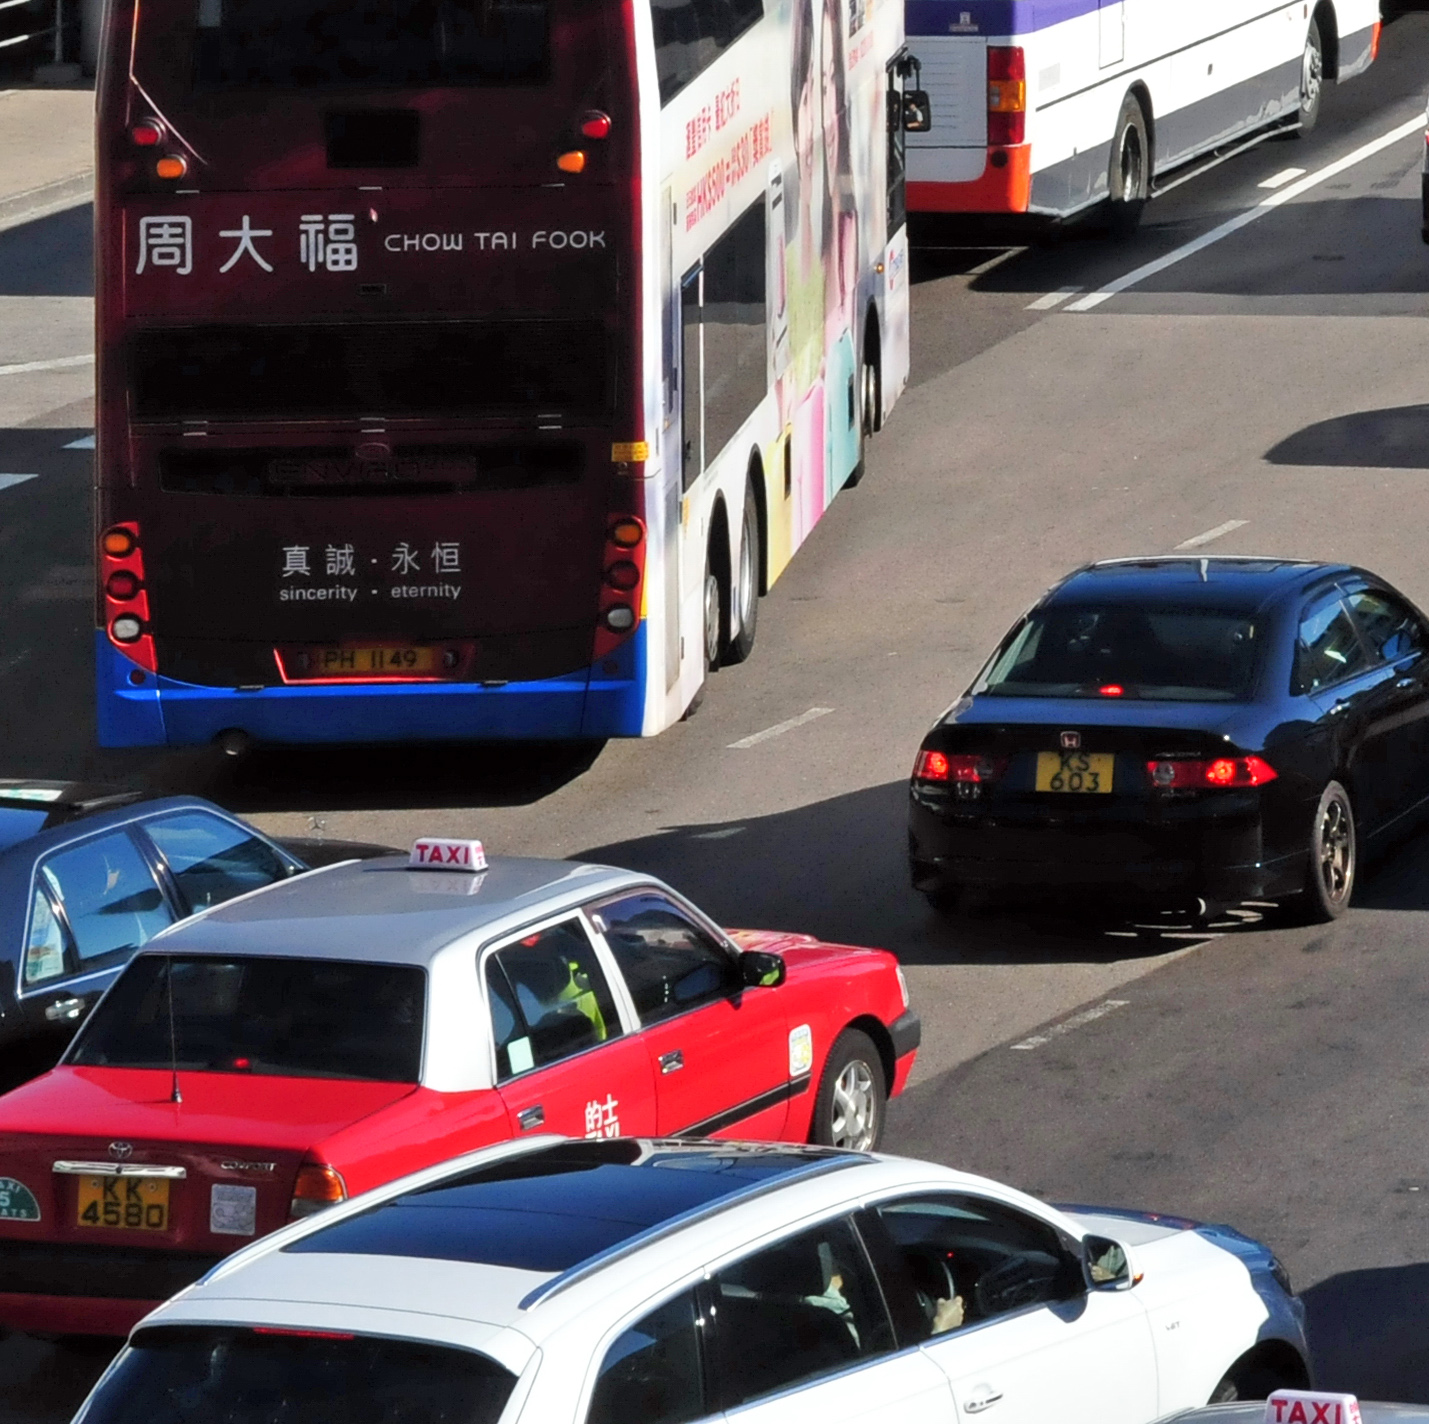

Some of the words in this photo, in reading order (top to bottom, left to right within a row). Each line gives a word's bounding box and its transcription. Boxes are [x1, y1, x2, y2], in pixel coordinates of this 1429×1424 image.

[135, 214, 358, 274] 周大福
[384, 232, 464, 252] CHOW
[474, 231, 517, 251] TAI
[532, 230, 606, 250] FOOK
[279, 583, 358, 602] sincerity
[391, 582, 462, 601] eternity
[324, 650, 356, 669] PH
[370, 650, 417, 668] 1149
[1060, 752, 1092, 771] KS
[1051, 772, 1101, 792] 603
[415, 844, 470, 864] TAXI
[584, 1093, 619, 1133] 的士
[102, 1178, 143, 1201] KK
[83, 1202, 165, 1228] 4580
[1271, 1399, 1342, 1424] TAXI
